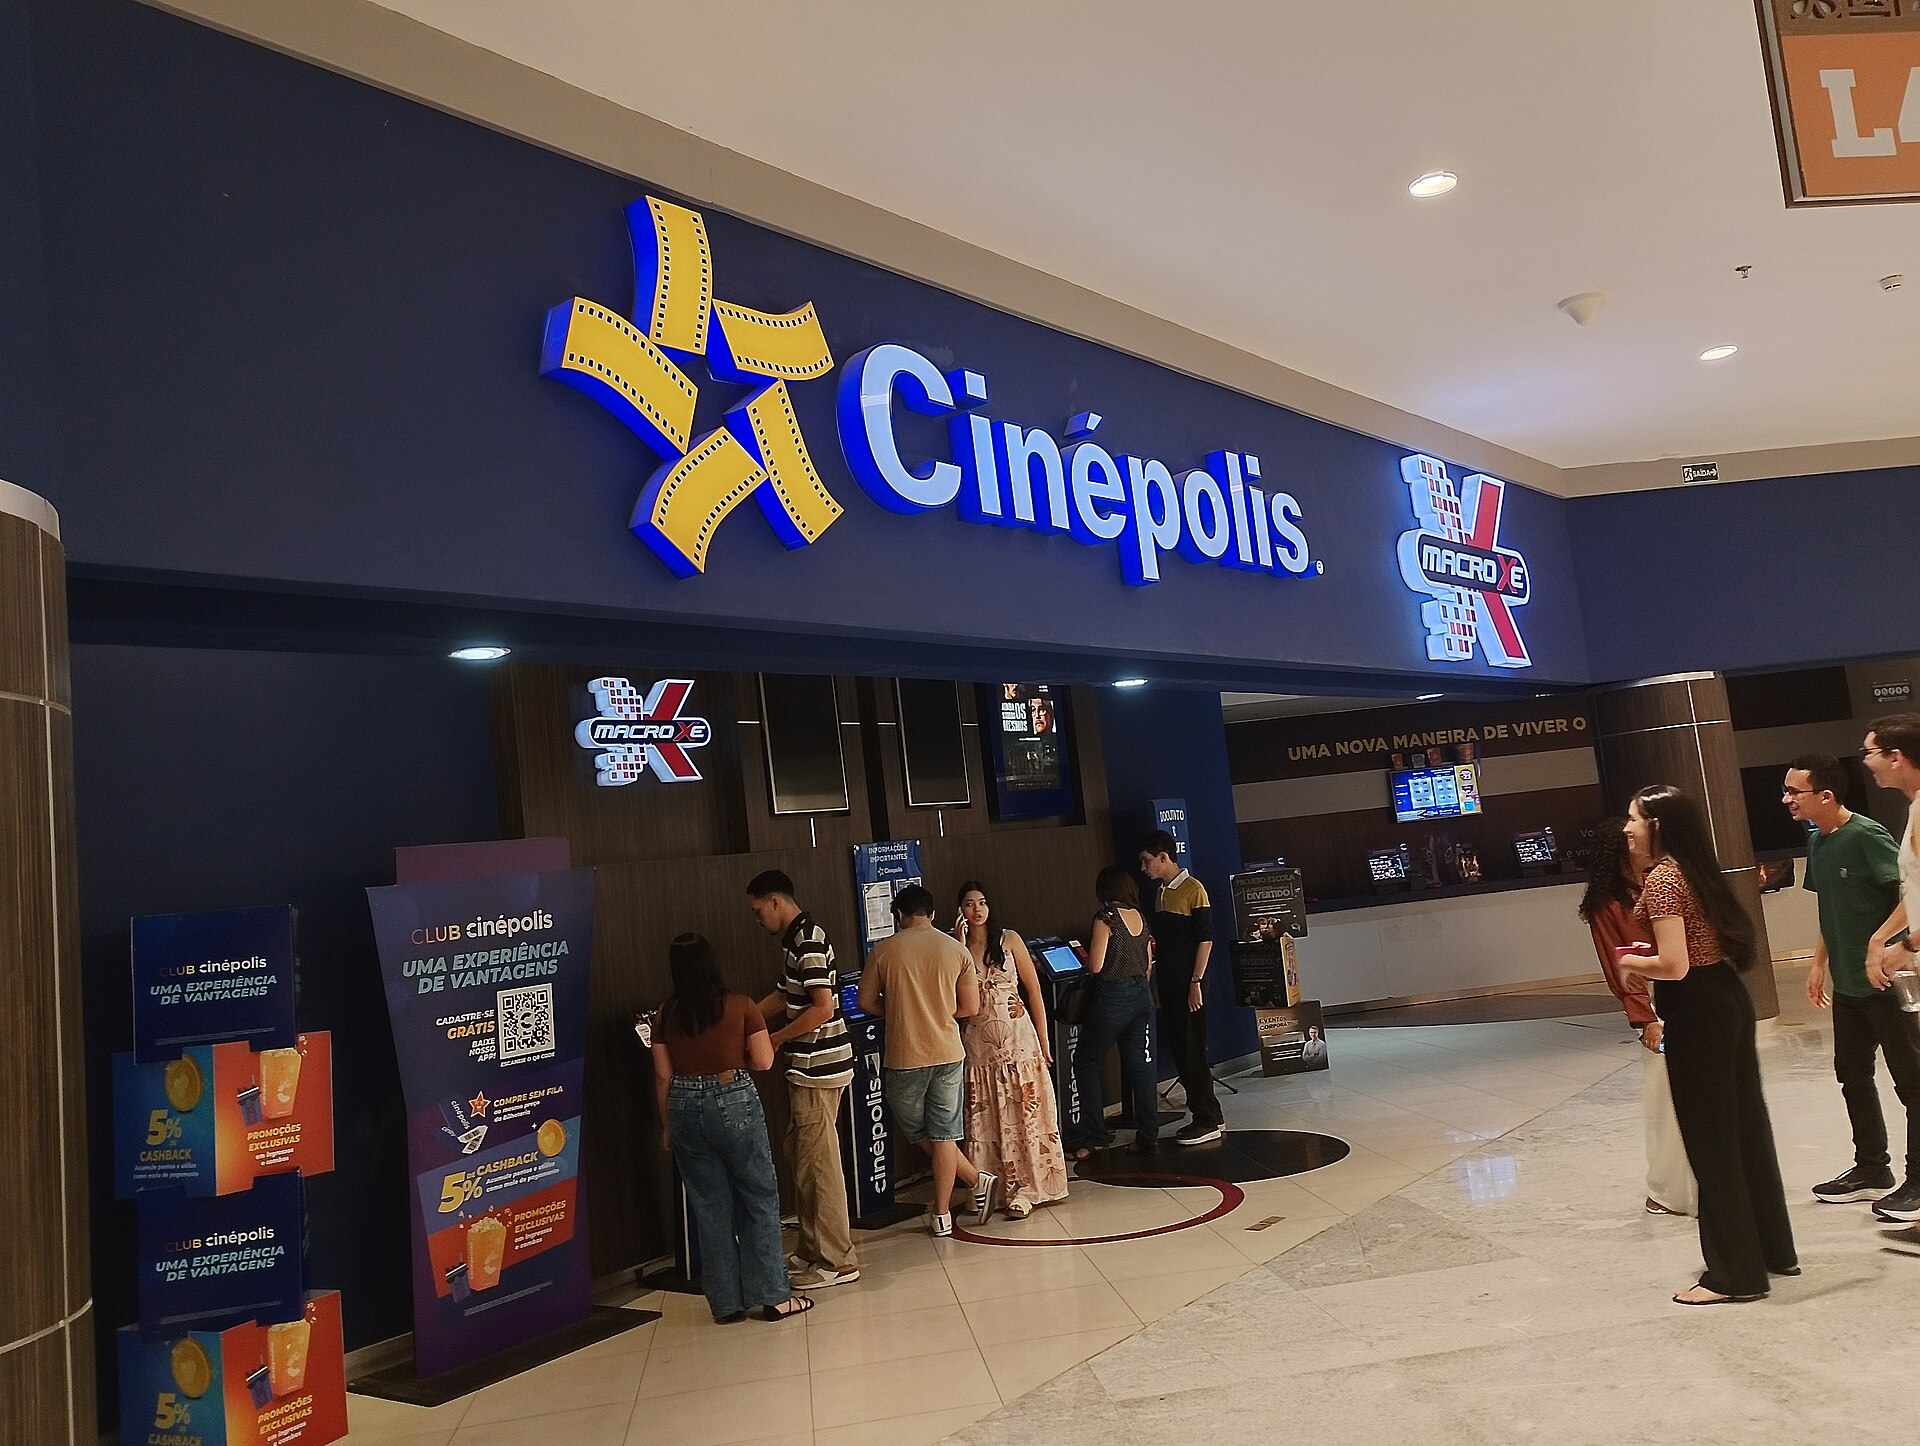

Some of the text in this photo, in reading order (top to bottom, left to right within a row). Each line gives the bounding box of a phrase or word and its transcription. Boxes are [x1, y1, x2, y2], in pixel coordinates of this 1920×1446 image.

[838, 342, 1312, 586] Cinépolis
[1287, 715, 1587, 762] UMA NOVA MANEIRA DE VIVER O
[868, 842, 908, 854] INFORMAÇÕES
[869, 852, 908, 863] IMPORTANTES
[411, 909, 554, 945] CLUB cinépolis
[159, 955, 267, 977] CLUB cinépolis
[402, 940, 570, 977] UMA EXPERIÊNCIA
[150, 975, 278, 995] UMA EXPERIÊNCIA
[418, 959, 559, 995] DE VANTAGENS
[160, 986, 268, 1005] DE VANTAGENS
[435, 1009, 495, 1026] CADASTRE-SE
[447, 1020, 496, 1040] GRÁTIS
[468, 1045, 496, 1057] NOSSO
[471, 1037, 496, 1048] BAIXE
[477, 1052, 497, 1062] APP!
[493, 1085, 564, 1107] COMPRE SEM FILA
[145, 1109, 183, 1146] 5%
[247, 1123, 302, 1141] PROMOÇÕES
[866, 1077, 887, 1193] cinépolis
[248, 1134, 301, 1152] EXCLUSIVAS
[140, 1148, 192, 1162] CASHBACK
[476, 1151, 539, 1176] CASHBACK
[438, 1171, 483, 1213] 5%
[514, 1199, 567, 1222] PROMOÇÕES
[514, 1211, 565, 1233] EXCLUSIVAS
[205, 1226, 275, 1247] cinépolis
[155, 1245, 285, 1272] UMA EXPERIÊNCIA
[166, 1257, 275, 1282] DE VANTAGENS
[257, 1394, 313, 1424] PROMOÇÕES
[260, 1406, 313, 1435] EXCLUSIVAS
